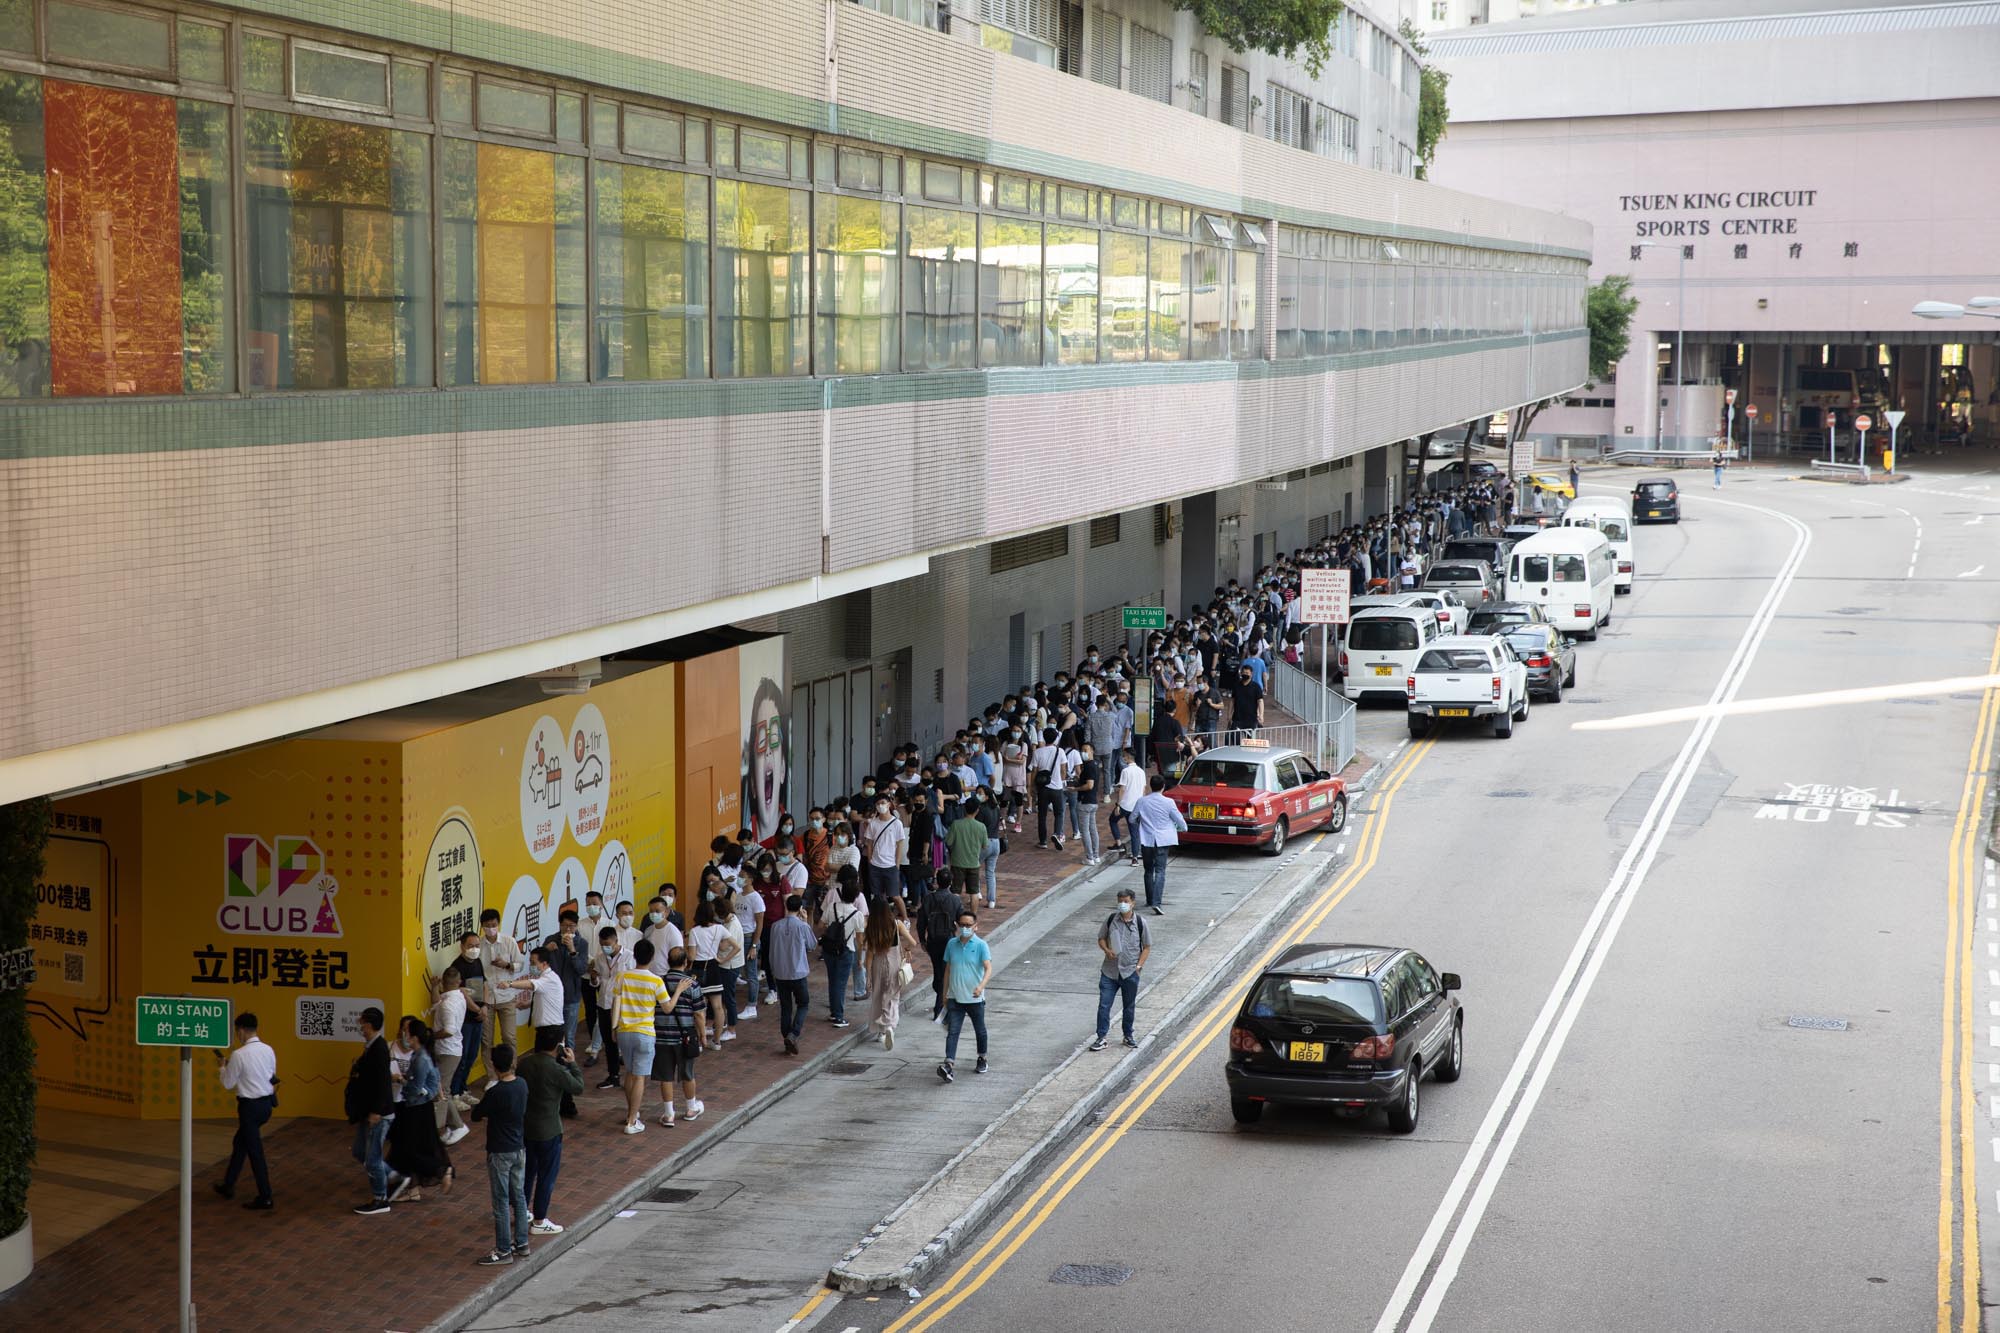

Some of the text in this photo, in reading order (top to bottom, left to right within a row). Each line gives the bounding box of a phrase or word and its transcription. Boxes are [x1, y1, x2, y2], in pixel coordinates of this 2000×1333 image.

[1620, 190, 1817, 211] TSUEN KING CIRCUIT
[1636, 218, 1798, 237] SPORTS CENTRE
[1131, 617, 1157, 625] 的士站
[1754, 804, 1911, 828] SLOW
[437, 844, 466, 872] 正式會員
[441, 874, 463, 911] 獨家
[220, 905, 308, 933] CLUB
[191, 944, 350, 990] 立即登記
[143, 1003, 223, 1017] TAXI STAND
[157, 1021, 209, 1038] 的士站
[1294, 1051, 1320, 1061] 1887
[1300, 1042, 1314, 1052] JE
